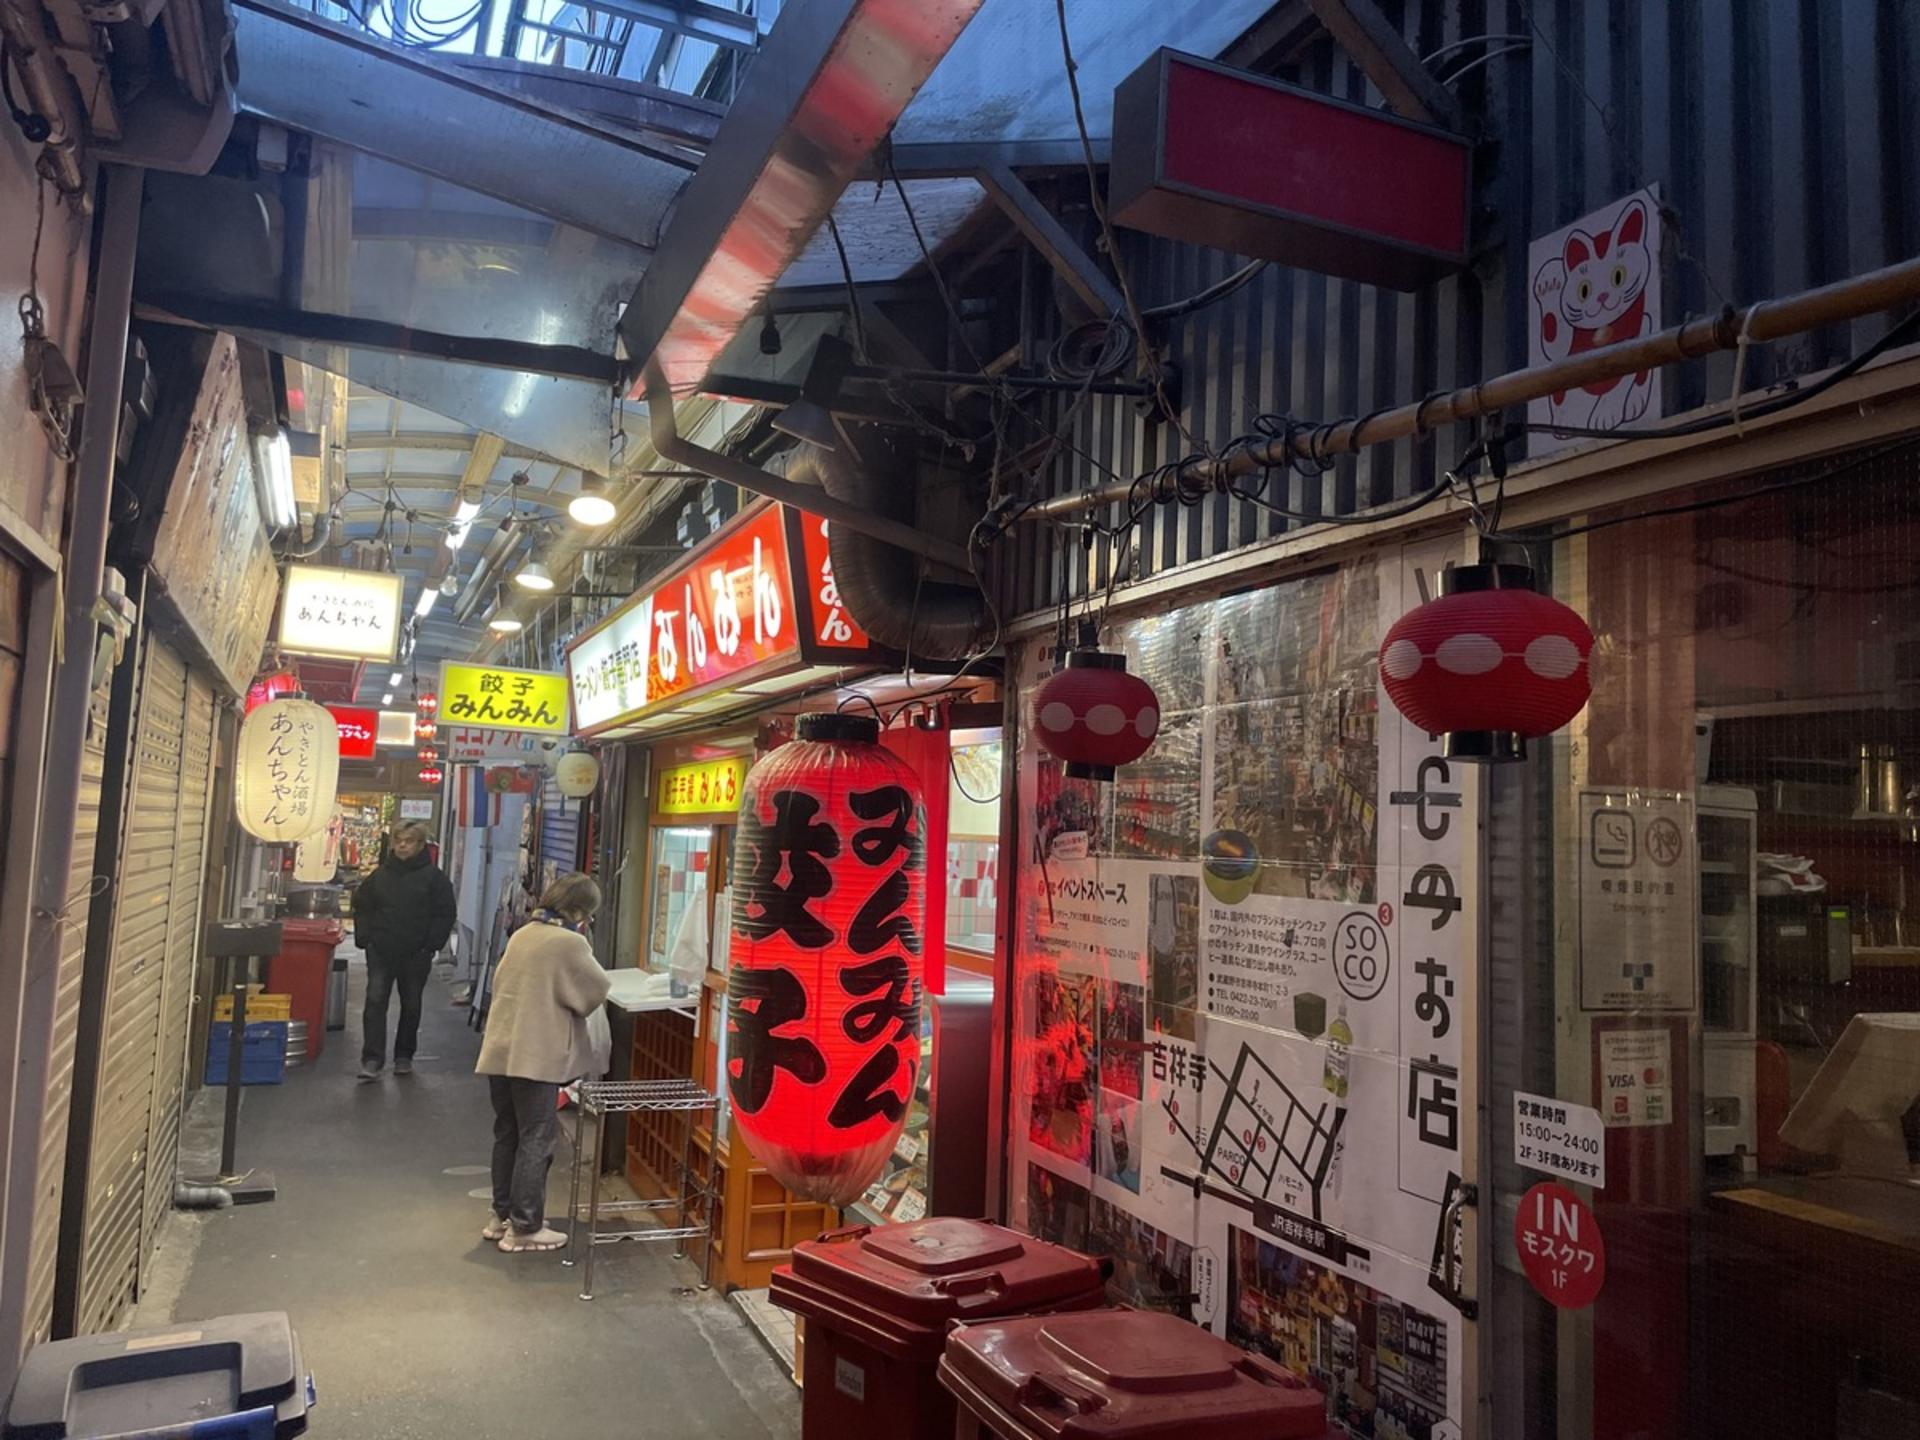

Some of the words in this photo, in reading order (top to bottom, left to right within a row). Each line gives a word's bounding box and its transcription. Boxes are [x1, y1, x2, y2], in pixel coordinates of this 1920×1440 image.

[298, 606, 382, 630] あんちゃん
[655, 536, 781, 683] みんみん
[480, 673, 535, 696] 餃子
[450, 693, 558, 725] みんみん
[263, 711, 294, 826] あんちゃん
[290, 721, 315, 817] やきとん酒場
[1345, 924, 1378, 952] SO
[827, 785, 926, 1130] みんみん
[1343, 954, 1378, 981] CO
[1151, 1039, 1207, 1093] 吉祥寺
[1607, 1074, 1637, 1089] VISA
[1517, 1100, 1567, 1126] 営業時間
[1217, 1147, 1246, 1167] PARCO
[1271, 1213, 1326, 1250] JR吉祥寺駅
[1536, 1192, 1579, 1243] IN
[1523, 1231, 1595, 1274] モスクワ
[1551, 1268, 1568, 1289] 1F
